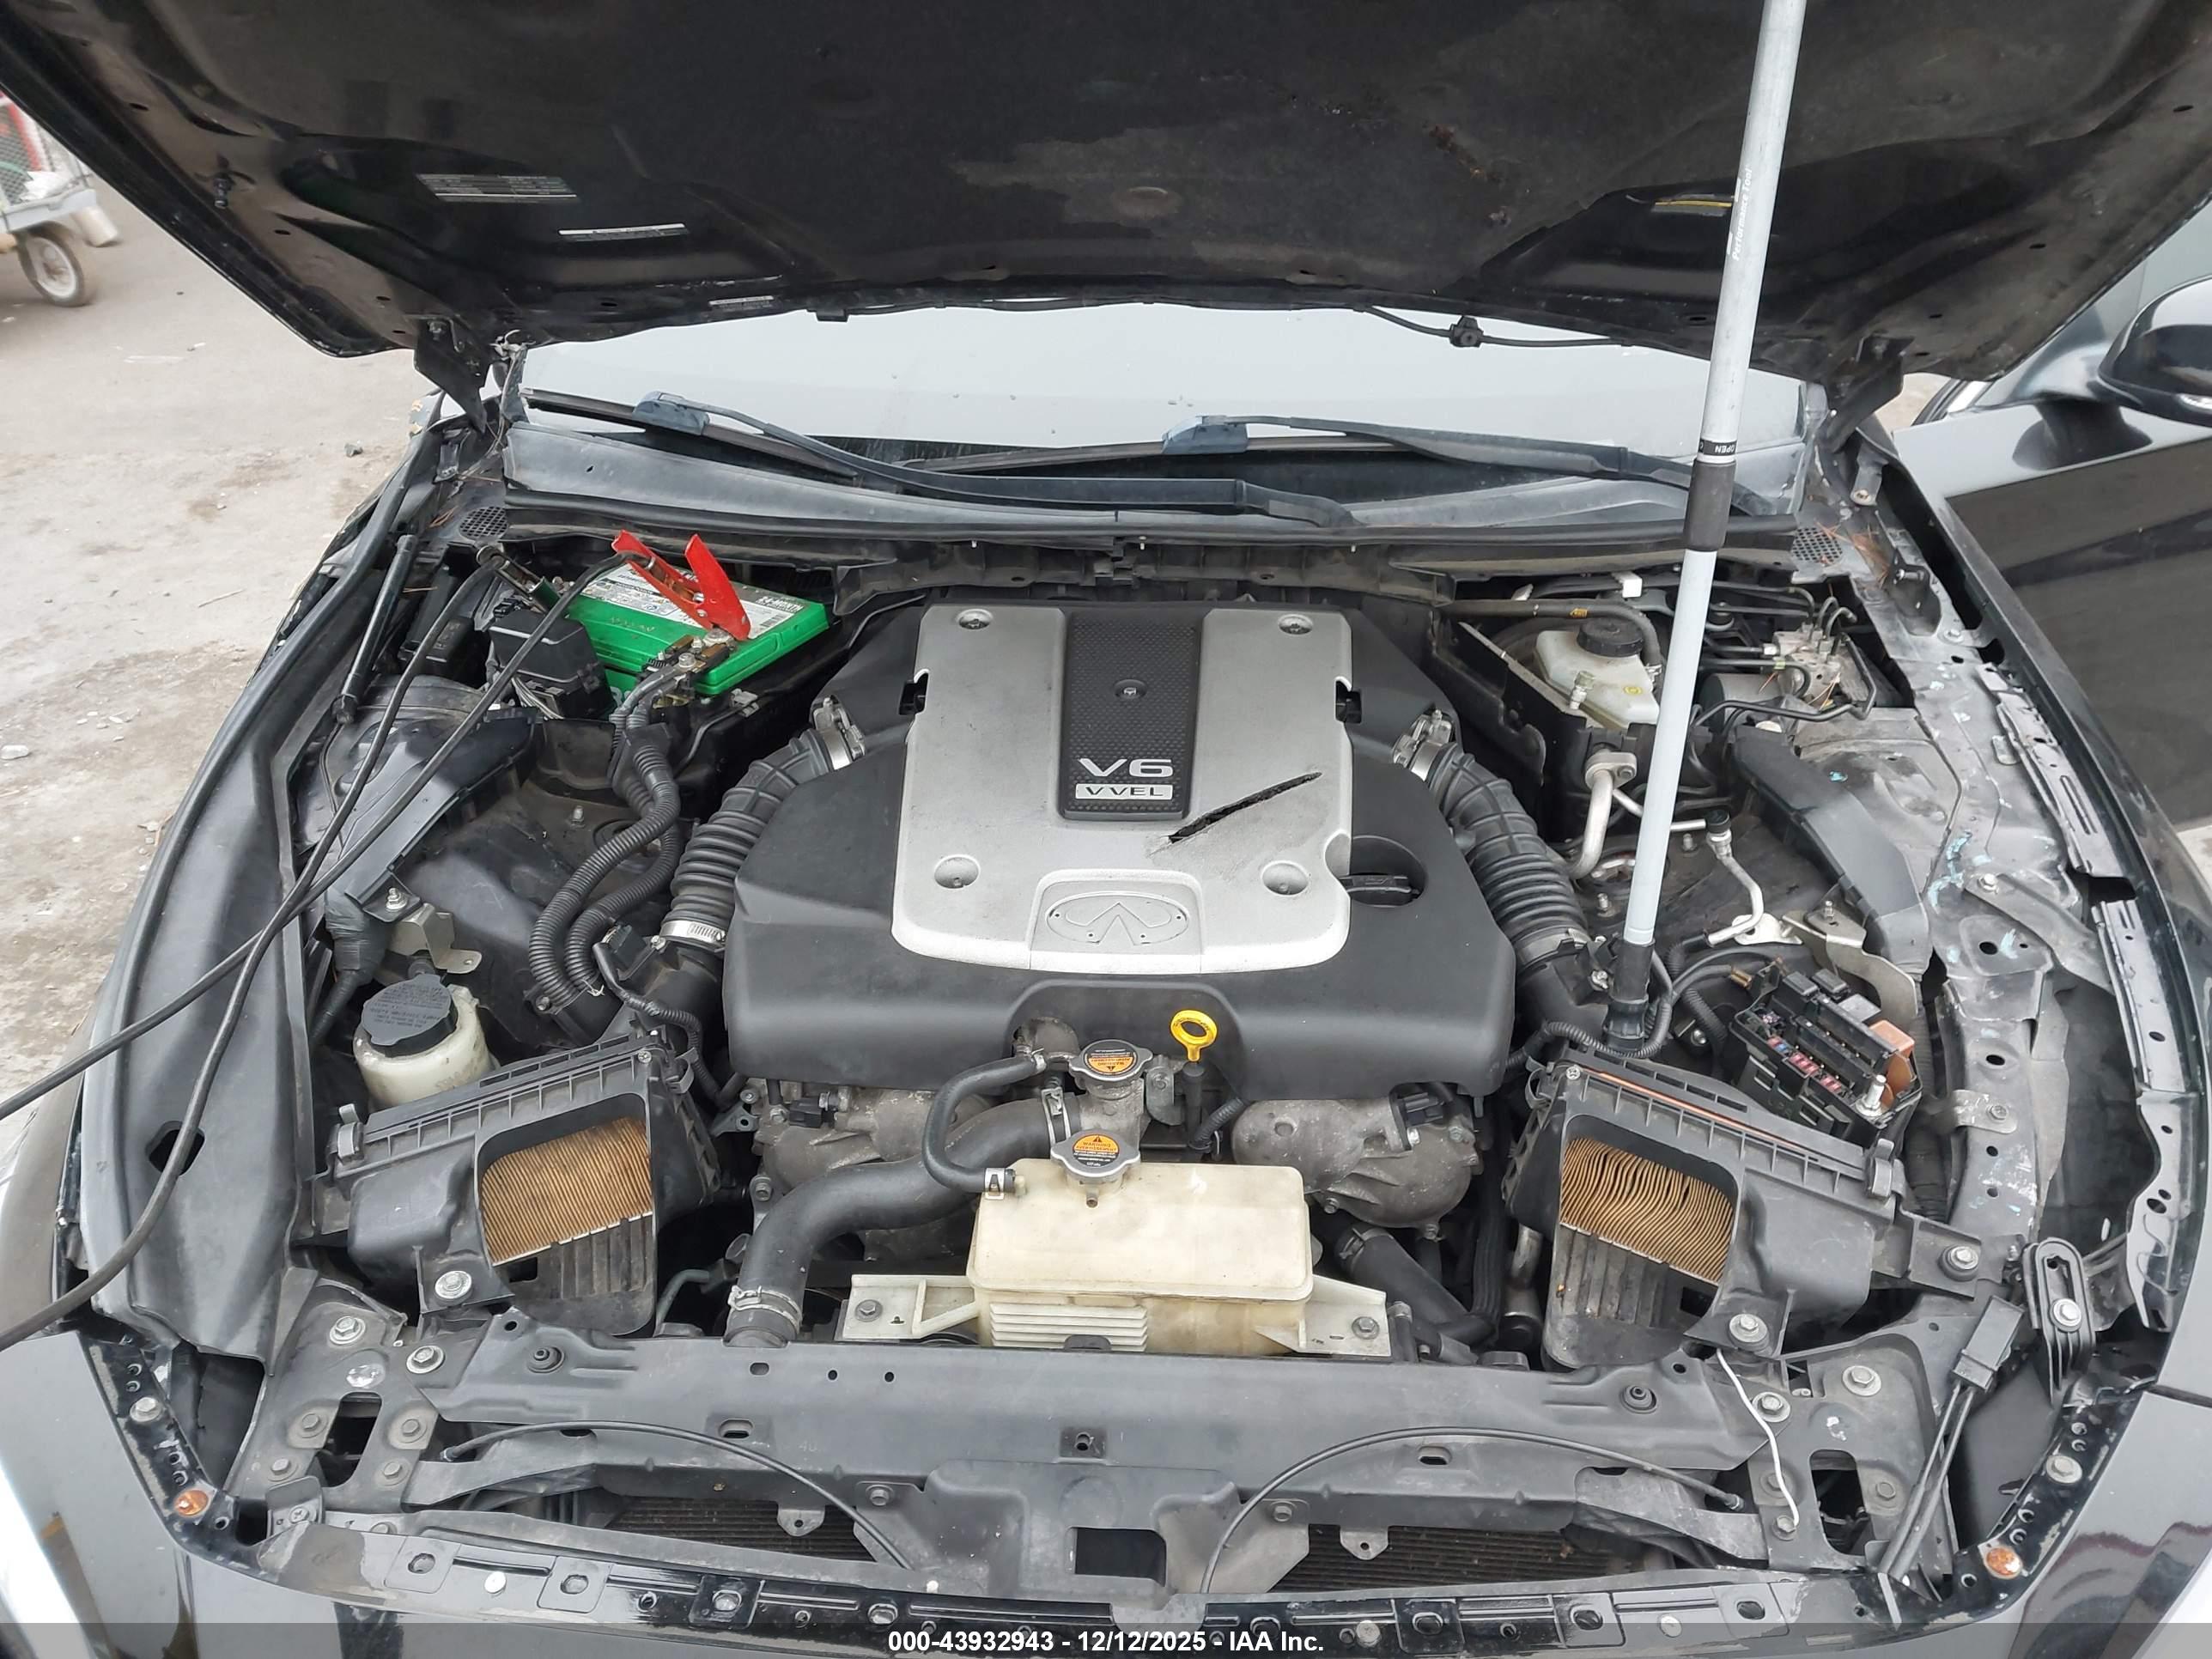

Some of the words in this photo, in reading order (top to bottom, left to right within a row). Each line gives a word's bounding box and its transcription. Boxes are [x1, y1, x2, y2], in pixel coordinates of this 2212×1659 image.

[1732, 194, 1748, 261] Performance
[1741, 167, 1753, 191] Tool
[1714, 444, 1735, 453] OPEN
[1078, 757, 1174, 778] V6
